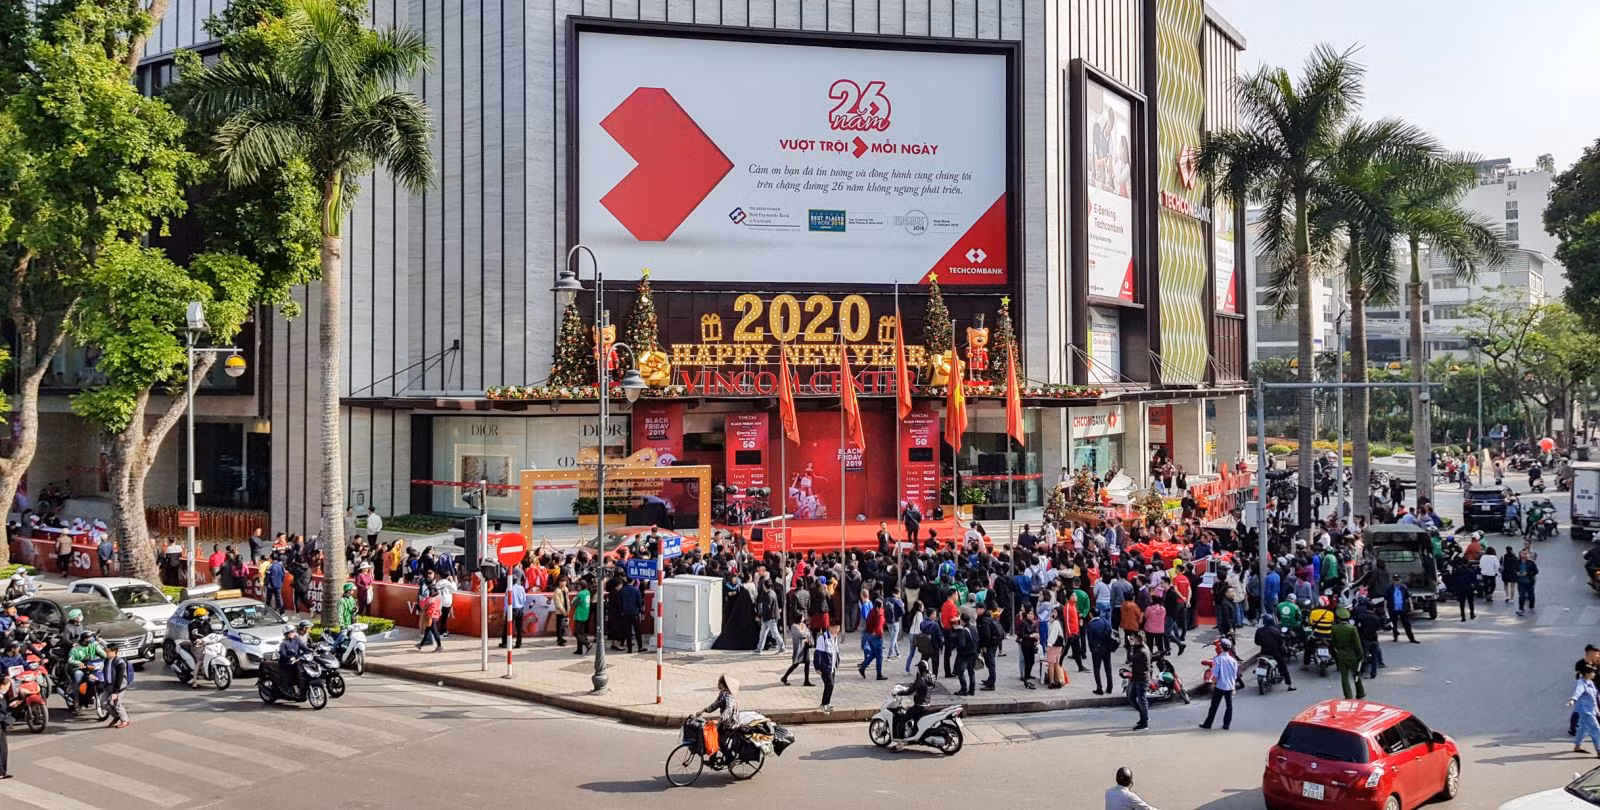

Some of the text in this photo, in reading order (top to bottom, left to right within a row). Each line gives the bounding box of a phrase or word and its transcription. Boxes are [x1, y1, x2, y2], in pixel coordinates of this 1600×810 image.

[829, 79, 891, 124] 26
[832, 108, 890, 131] năm
[780, 139, 938, 155] VƯỢT TRỘI MỖI NGÀY
[784, 165, 800, 176] bạn
[816, 166, 827, 176] tin
[855, 169, 866, 178] và
[891, 168, 911, 179] hành
[936, 170, 960, 183] chúng
[961, 171, 972, 181] tôi
[757, 180, 773, 189] trên
[831, 182, 844, 191] 26
[867, 182, 891, 195] không
[921, 184, 940, 196] phát
[949, 266, 1003, 275] TECHCOMBANK
[733, 294, 870, 342] 2020
[672, 344, 772, 366] HAPPY
[783, 345, 842, 366] NEW
[471, 424, 498, 436] DIOR
[630, 567, 639, 576] BÀ
